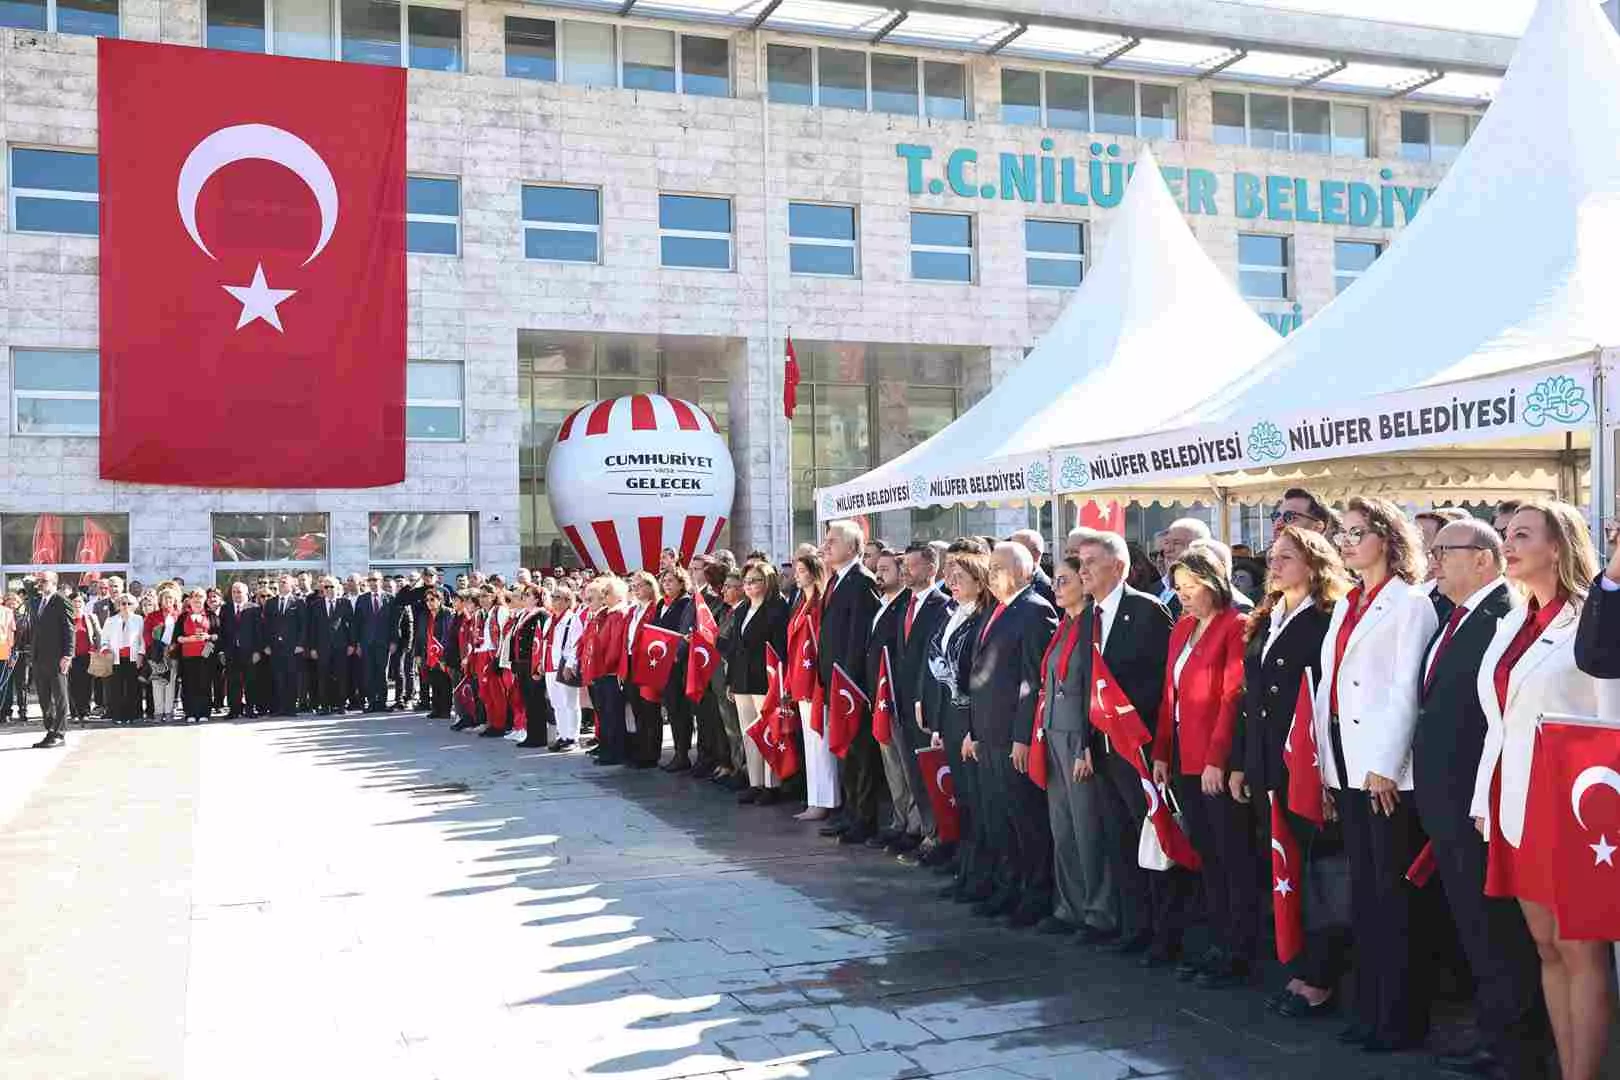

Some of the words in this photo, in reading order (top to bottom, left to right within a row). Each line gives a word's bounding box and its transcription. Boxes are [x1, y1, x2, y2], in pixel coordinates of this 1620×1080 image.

[1233, 167, 1438, 229] BELEDİY
[1288, 416, 1373, 452] NİLÜFER
[1378, 388, 1516, 440] BELEDİYESİ
[604, 452, 713, 468] CUMHURİYET
[1089, 452, 1150, 481] NİLÜFER
[1151, 431, 1243, 472] BELEDİYESİ
[626, 477, 702, 490] GELECEK
[929, 475, 968, 497] NİLÜFER
[969, 467, 1025, 494] BELEDİYESİ
